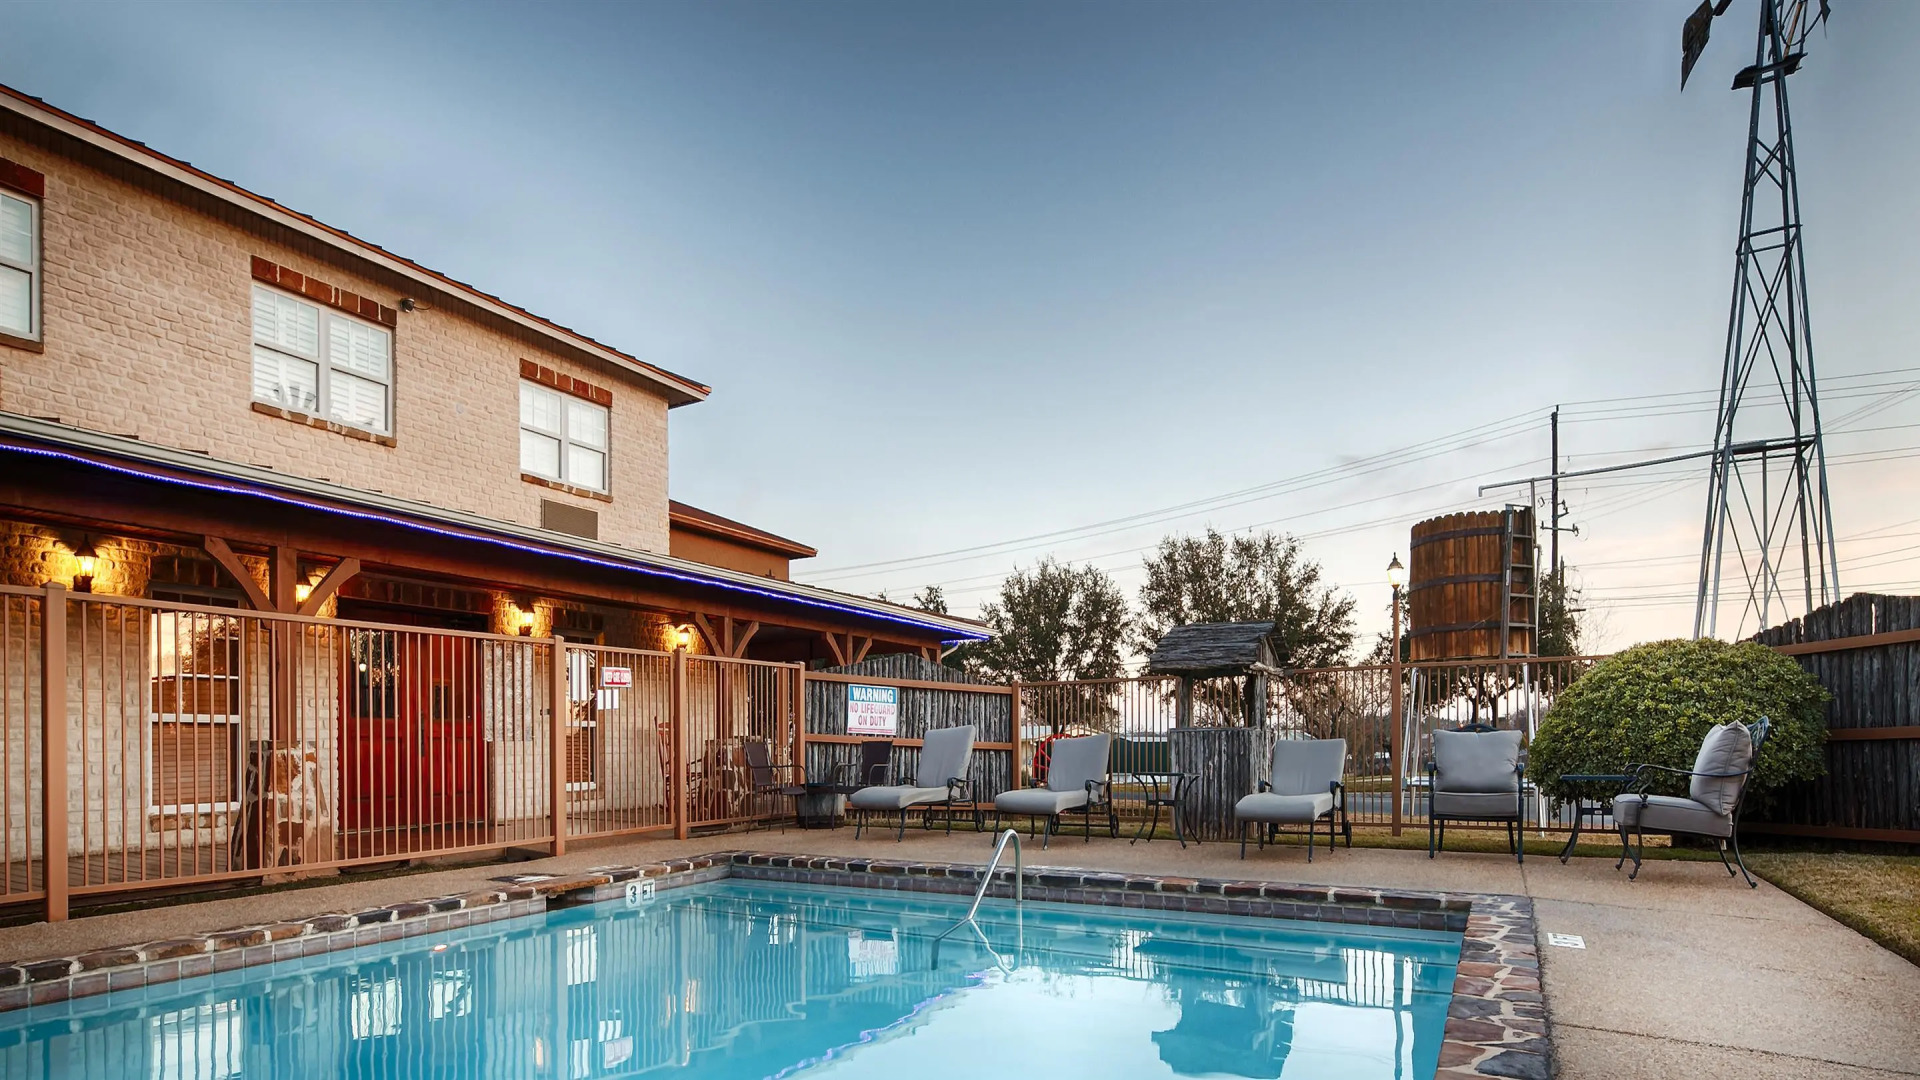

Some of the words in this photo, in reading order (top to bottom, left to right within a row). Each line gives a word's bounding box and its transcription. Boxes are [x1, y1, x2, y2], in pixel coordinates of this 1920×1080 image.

[853, 687, 893, 702] WARNING
[850, 703, 858, 713] NO
[861, 704, 895, 715] LIFEGUARD
[858, 715, 867, 726] ON
[870, 716, 887, 726] DUTY
[630, 885, 637, 904] 3
[642, 882, 654, 901] FT
